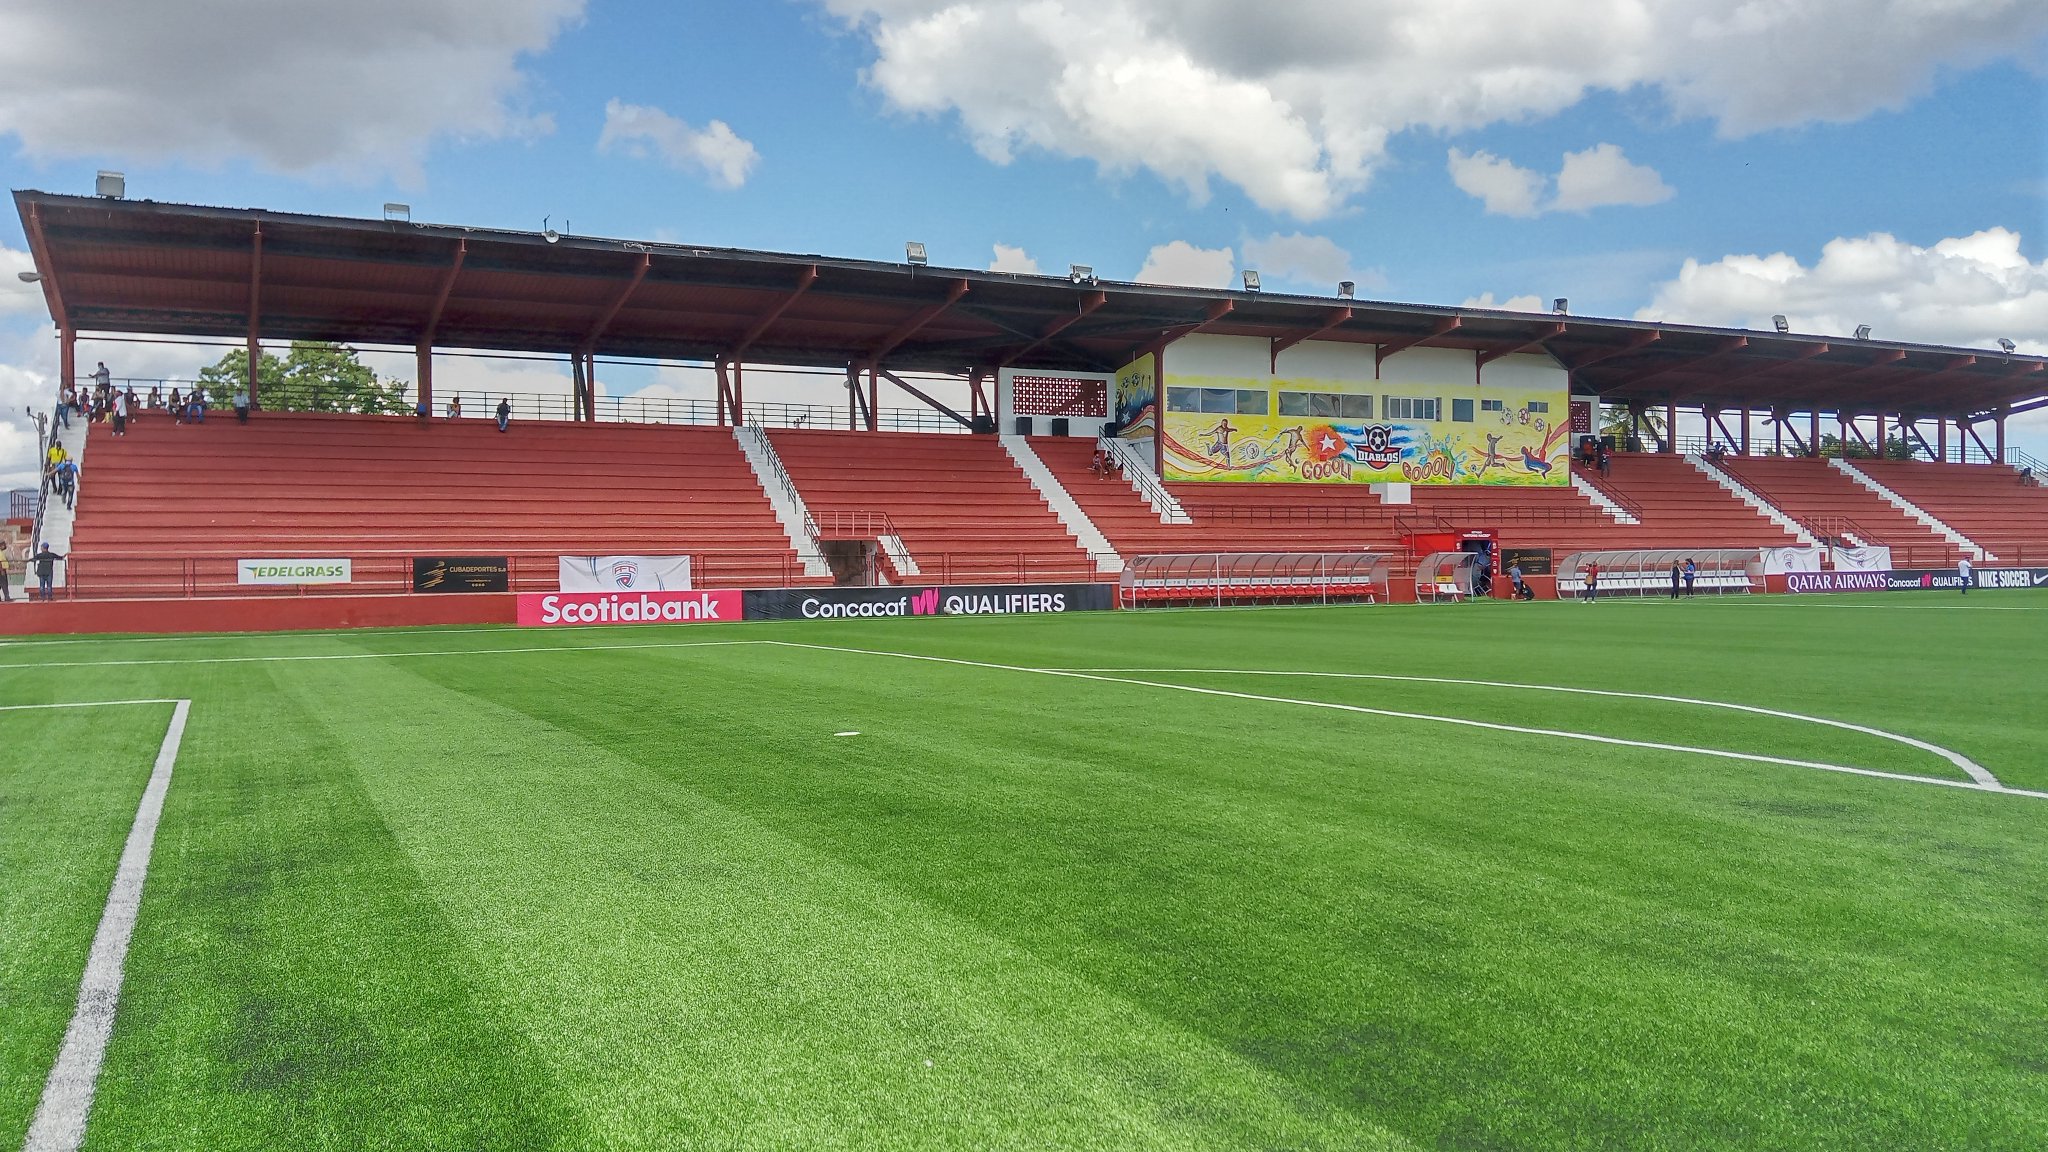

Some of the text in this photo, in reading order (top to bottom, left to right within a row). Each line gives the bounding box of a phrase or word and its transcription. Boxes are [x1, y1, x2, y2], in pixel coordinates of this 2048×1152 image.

[1357, 450, 1399, 463] DIABLOS
[1787, 573, 1886, 593] QATAR AIRWAYS
[1887, 578, 1921, 588] Concacaf
[1932, 576, 1973, 587] QUALIFIES
[1978, 570, 2031, 588] NIKE SOCCER
[541, 593, 720, 624] Scotiabank
[801, 596, 907, 619] Concacaf
[945, 593, 1066, 615] QUALIFIERS
